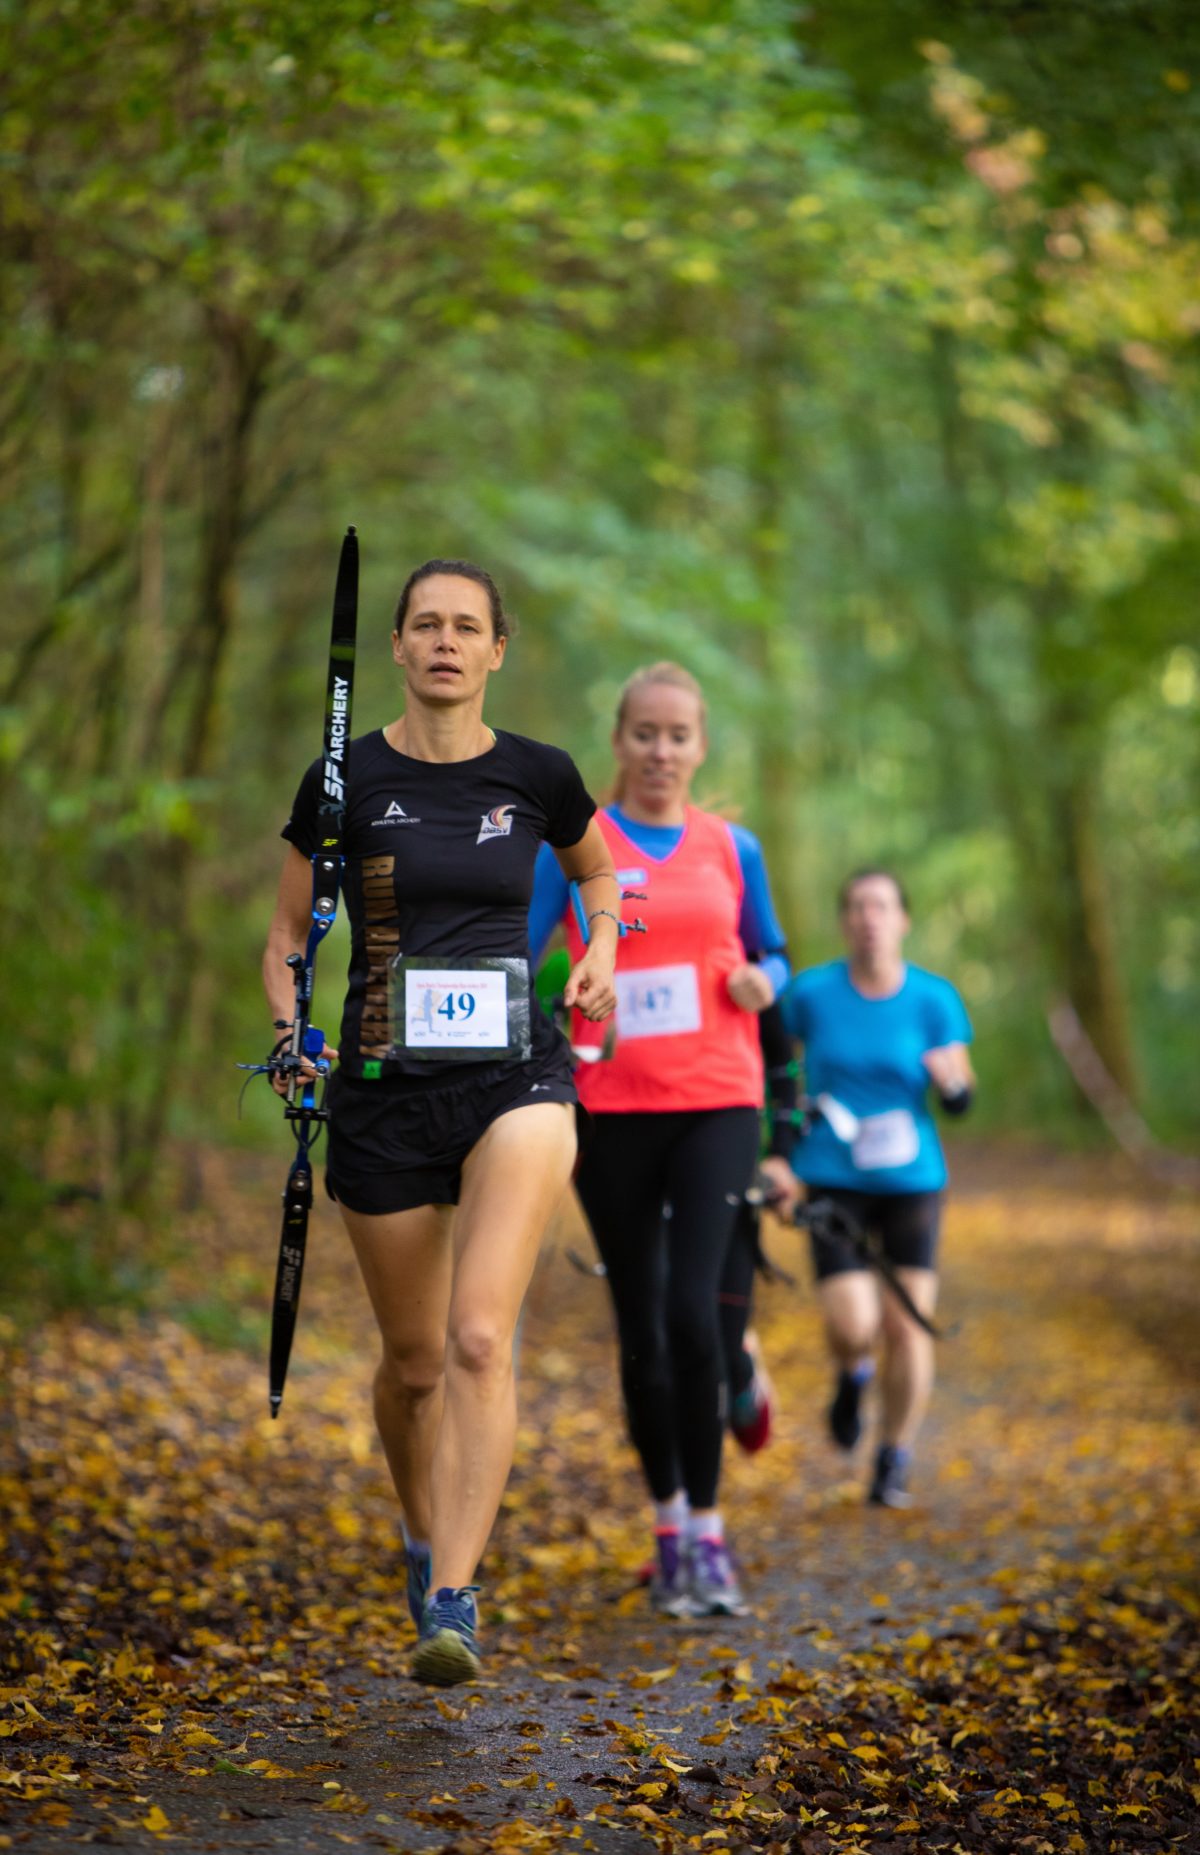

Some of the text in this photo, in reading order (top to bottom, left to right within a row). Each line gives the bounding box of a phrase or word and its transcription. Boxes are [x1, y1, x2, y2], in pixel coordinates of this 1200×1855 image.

[324, 676, 349, 801] SF ARCHERY
[322, 838, 339, 847] SF
[359, 855, 401, 1059] RUN ARCHERY
[437, 991, 476, 1021] 49
[640, 986, 673, 1010] 47
